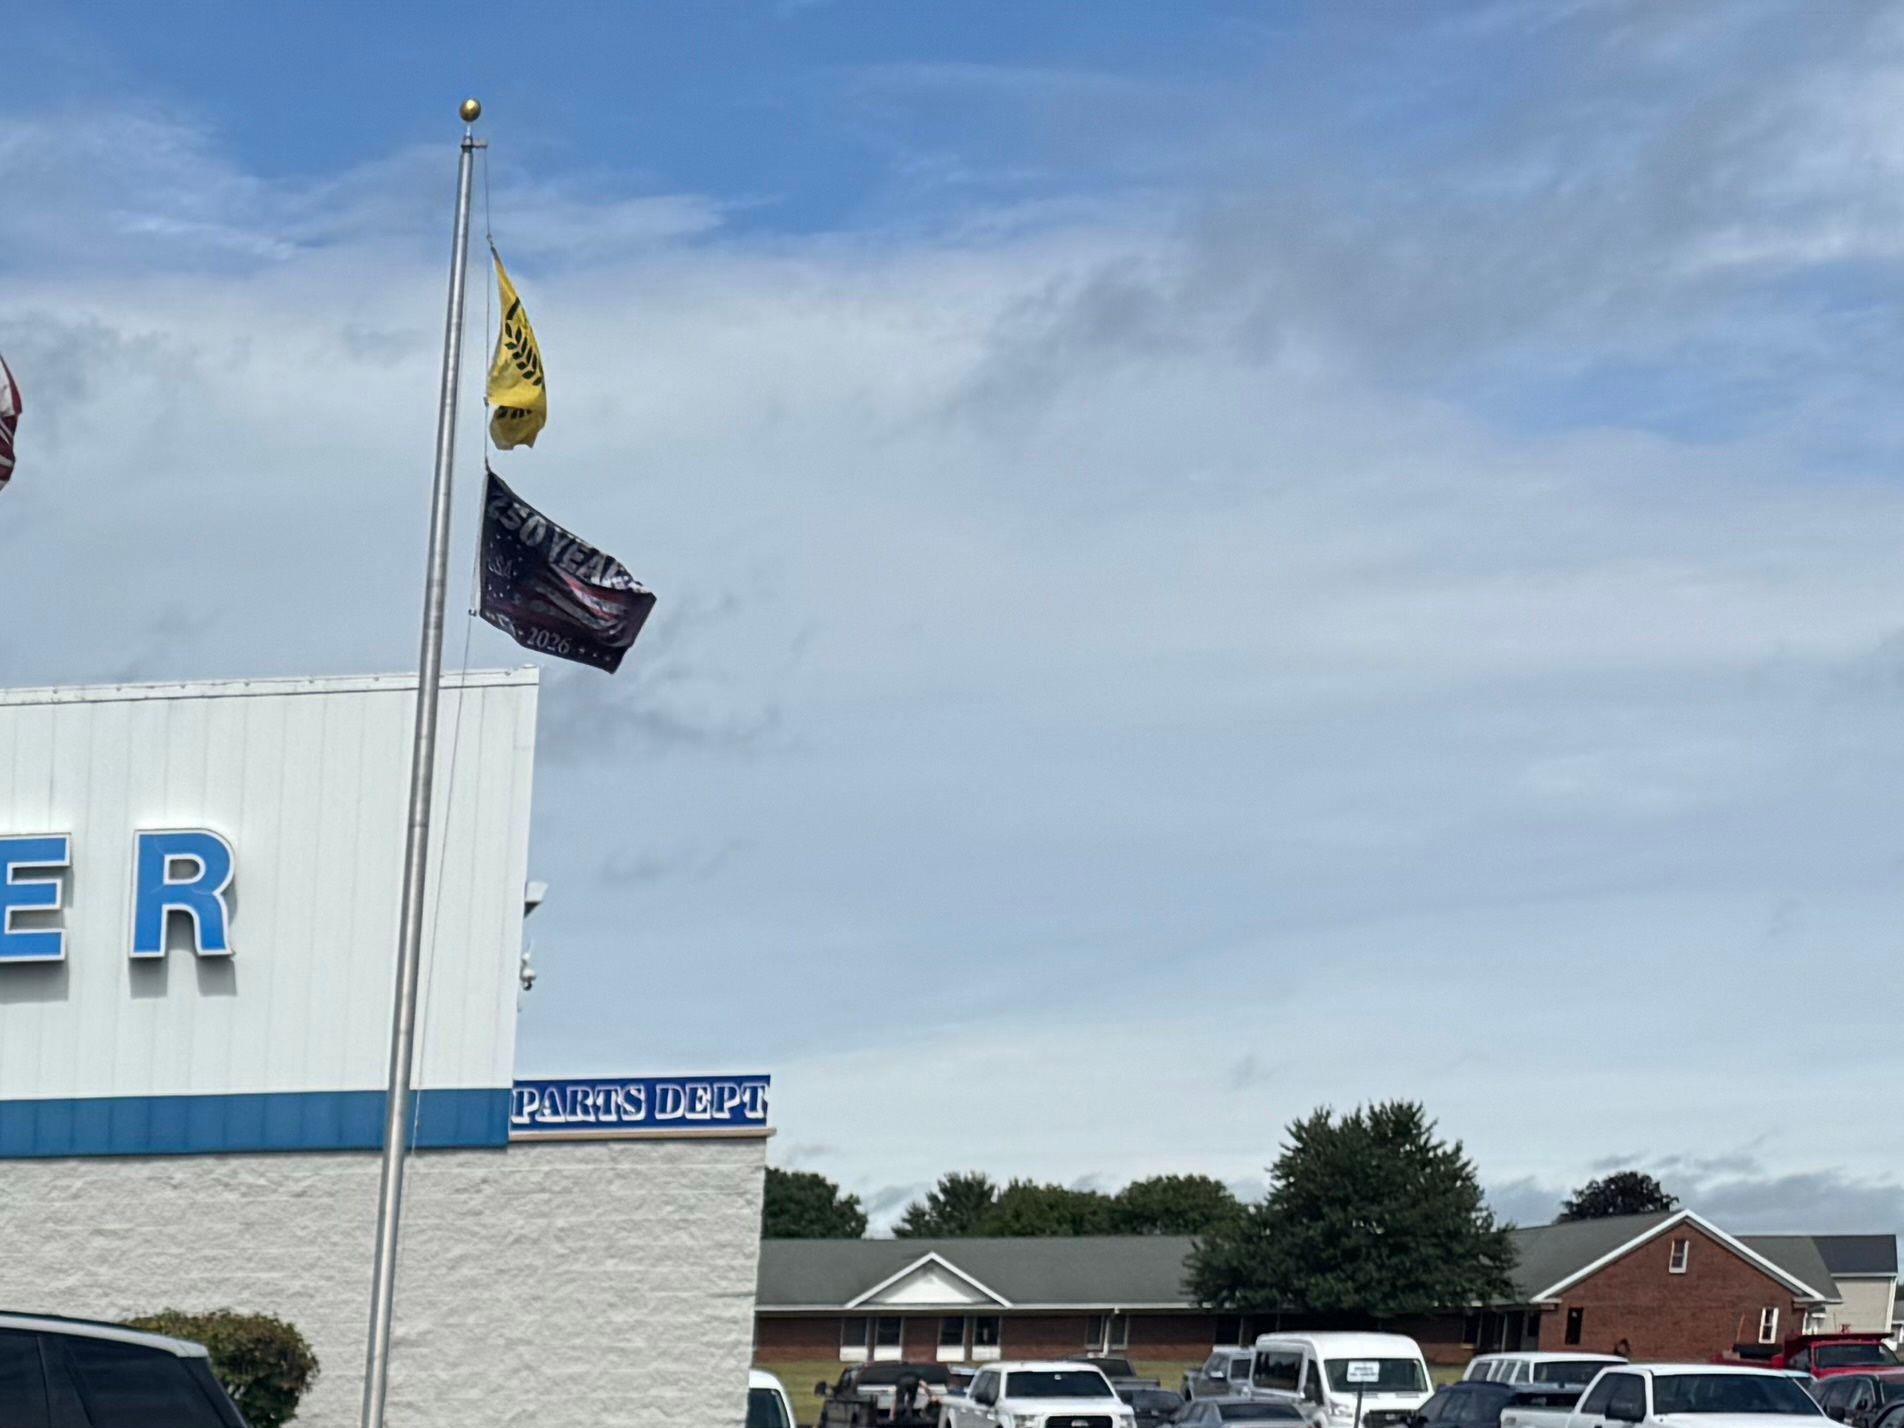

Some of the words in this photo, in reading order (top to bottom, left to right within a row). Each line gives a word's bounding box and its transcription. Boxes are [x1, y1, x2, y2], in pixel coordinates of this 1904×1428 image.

[527, 627, 570, 653] 2026
[511, 1085, 646, 1124] PARTS
[654, 1082, 769, 1120] DEPT
